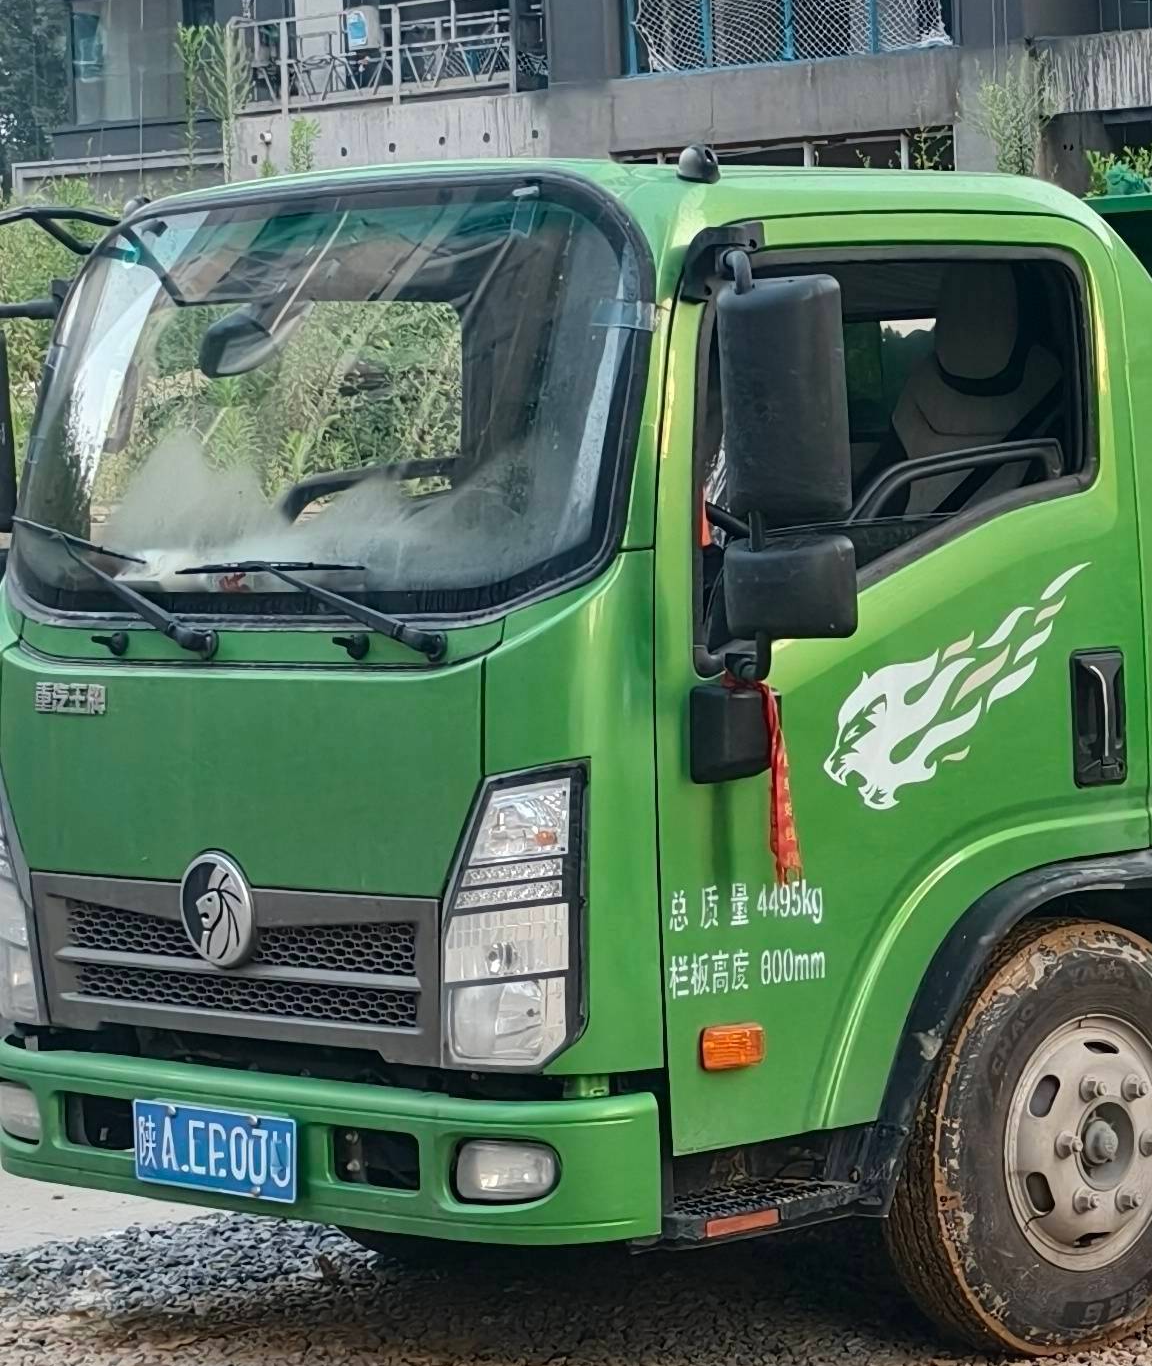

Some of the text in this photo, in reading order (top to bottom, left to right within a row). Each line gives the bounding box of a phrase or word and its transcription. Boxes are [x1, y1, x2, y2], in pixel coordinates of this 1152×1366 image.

[35, 682, 106, 715] 重汽王牌
[757, 879, 823, 924] 4495kg
[669, 948, 826, 999] 栏板高度 800mm
